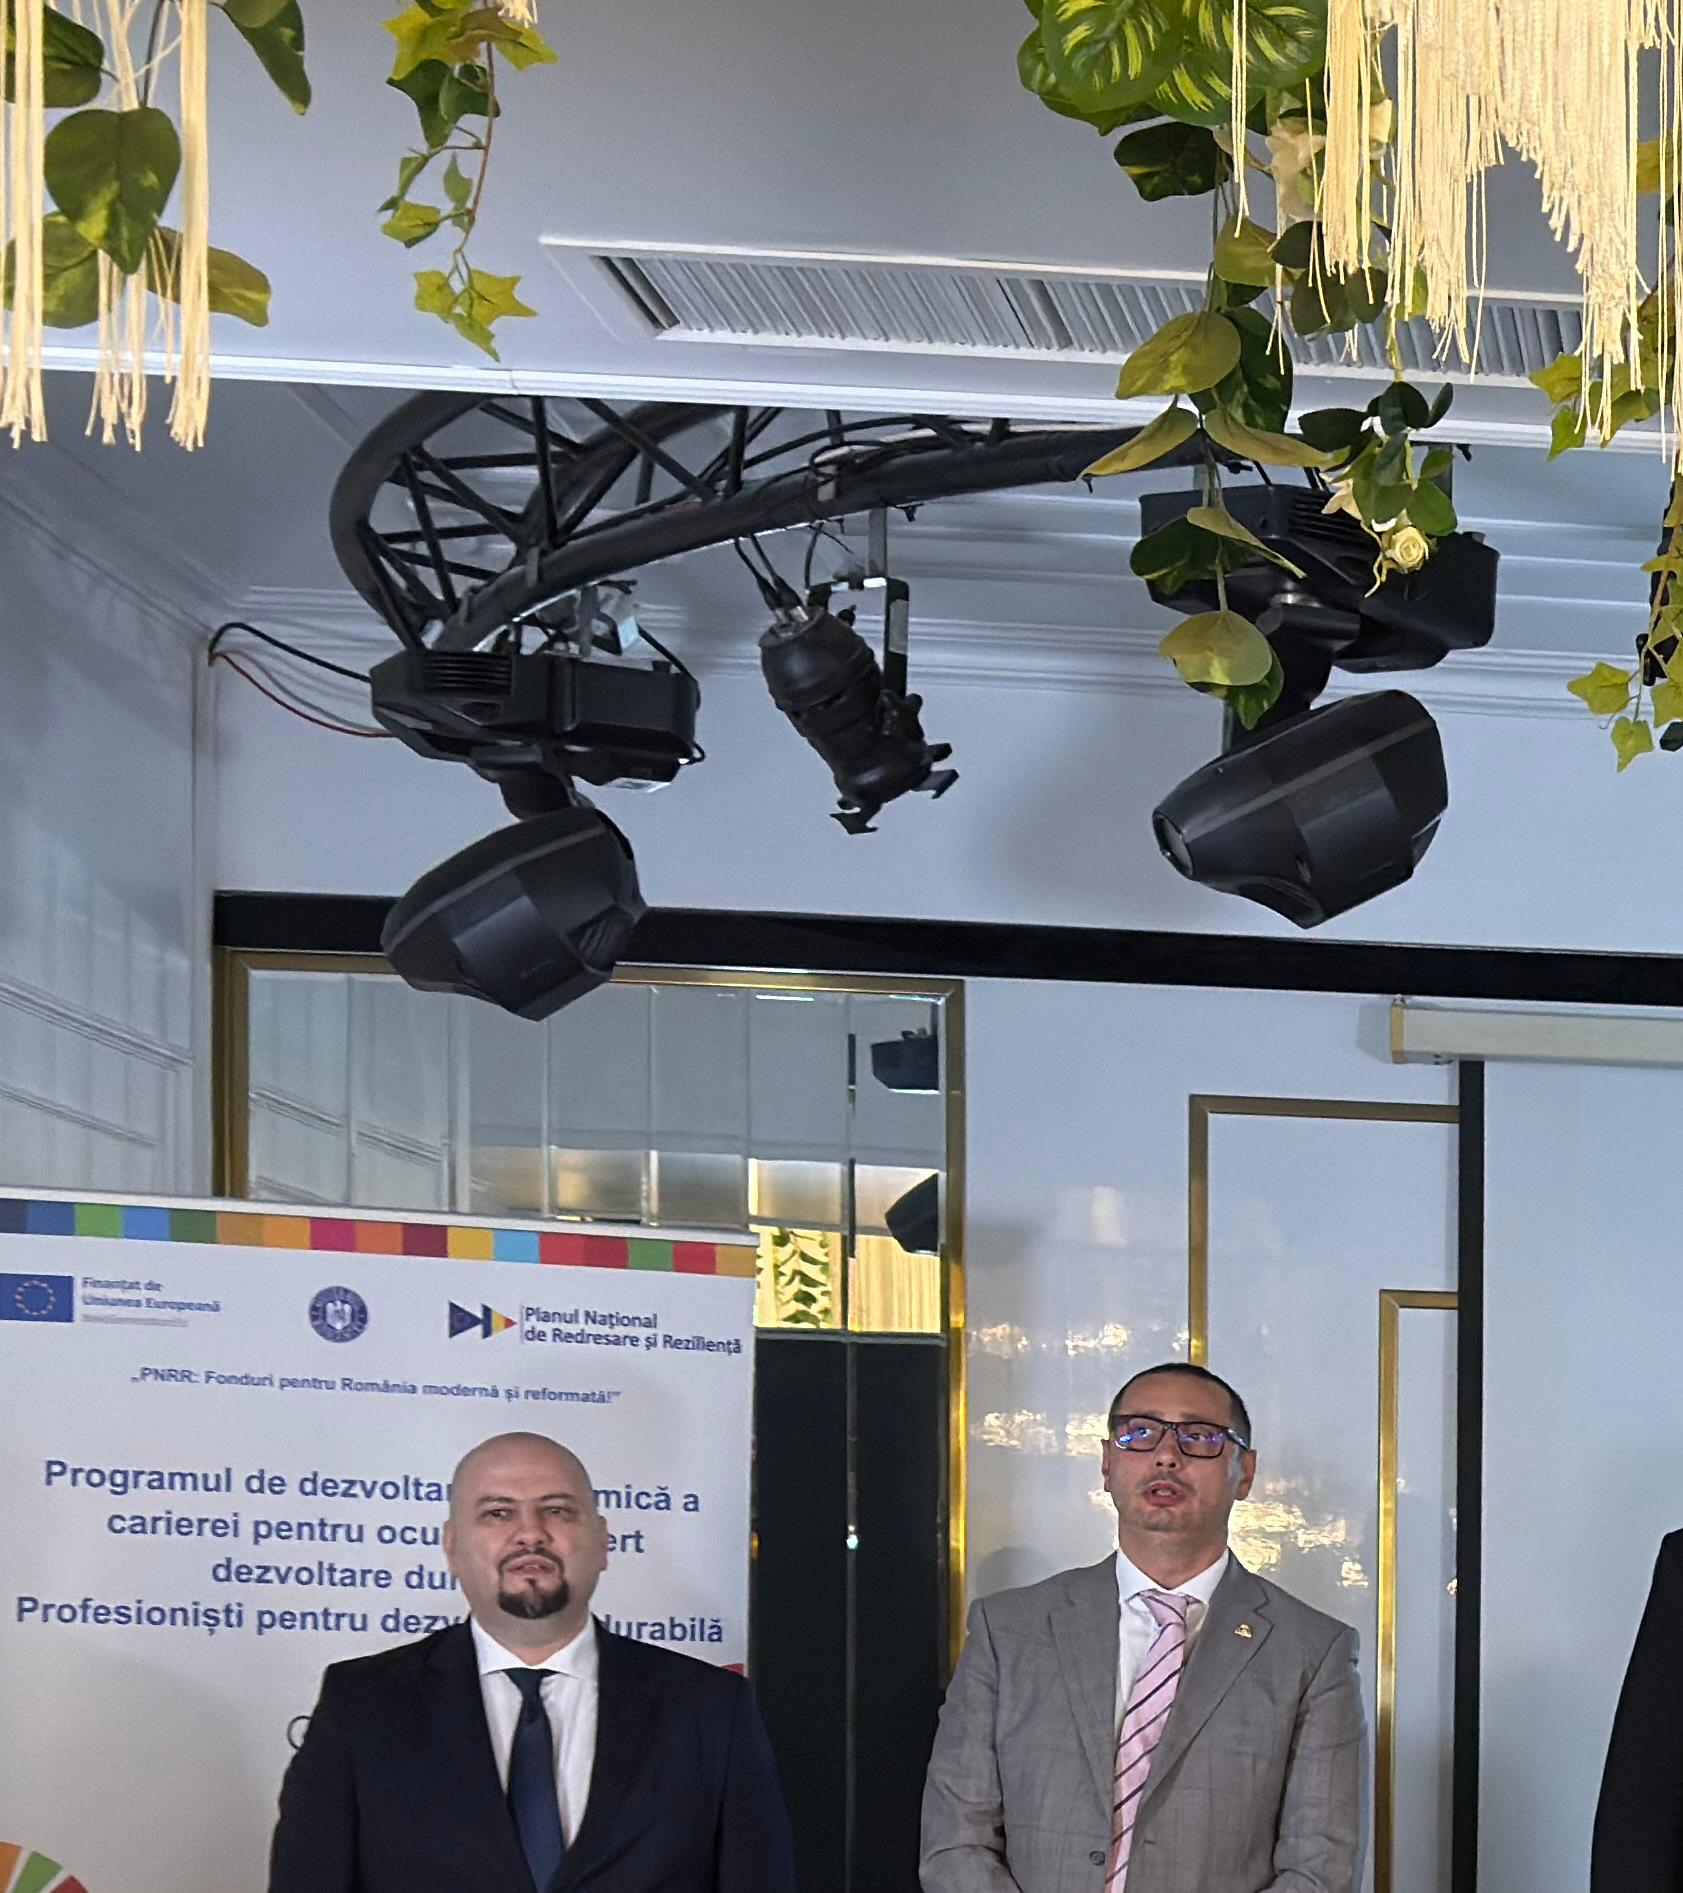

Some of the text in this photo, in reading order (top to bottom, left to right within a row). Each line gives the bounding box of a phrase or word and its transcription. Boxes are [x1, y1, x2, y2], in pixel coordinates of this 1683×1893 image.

[525, 1307, 657, 1330] Planul Național
[525, 1328, 546, 1343] de
[553, 1328, 640, 1347] Redresare
[205, 1370, 274, 1386] Fonduri
[279, 1375, 335, 1391] pentru
[341, 1377, 417, 1395] România
[45, 1460, 232, 1495] Programul
[245, 1469, 288, 1495] de
[299, 1471, 453, 1502] dezvolta
[683, 1493, 700, 1513] a
[107, 1511, 240, 1539] carierei
[253, 1520, 364, 1546] pentru
[607, 1530, 645, 1554] ert
[211, 1557, 392, 1590] dezvoltare
[16, 1597, 243, 1636] Profesioniști
[256, 1606, 368, 1635] pentru
